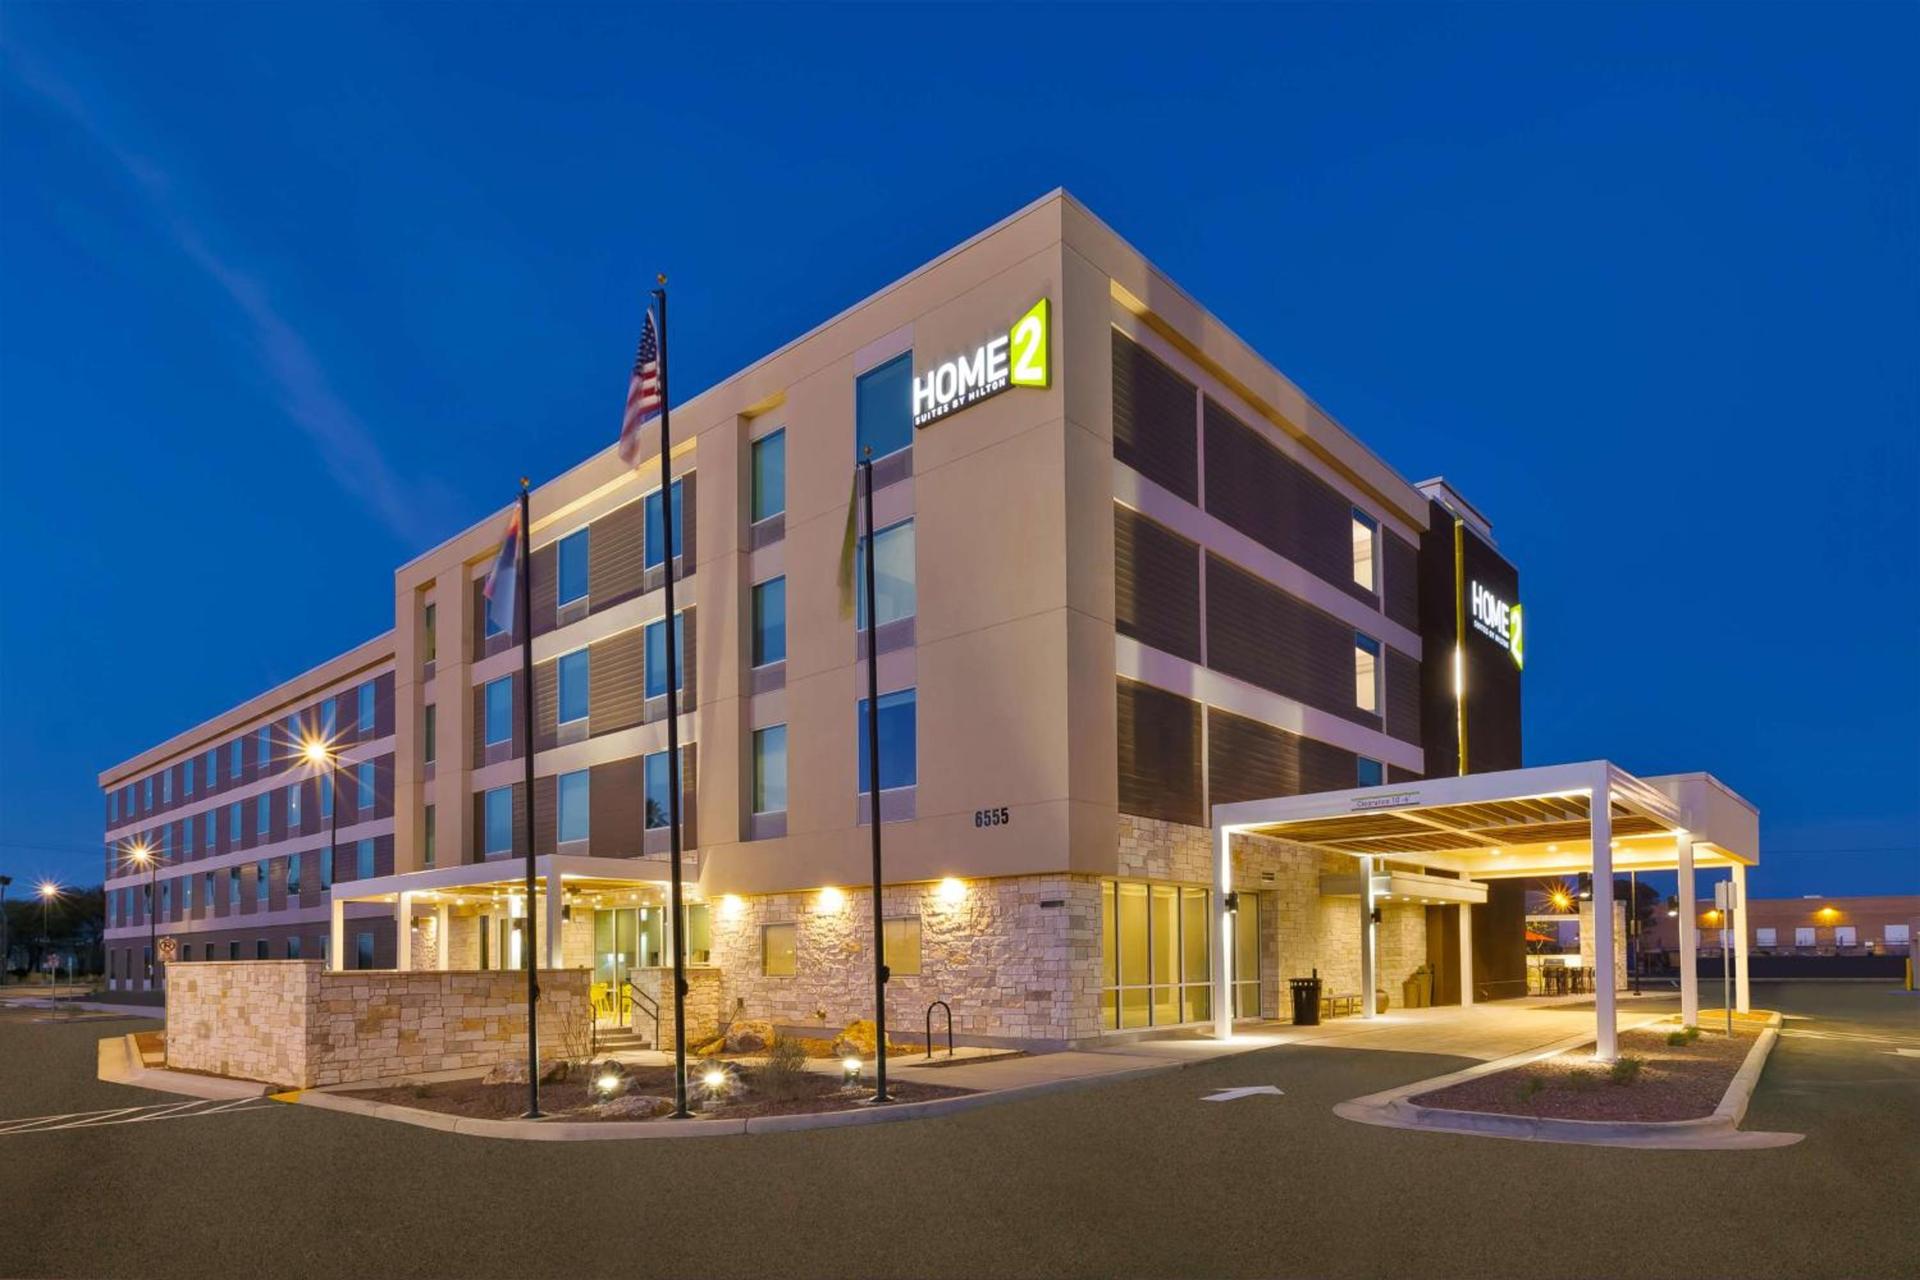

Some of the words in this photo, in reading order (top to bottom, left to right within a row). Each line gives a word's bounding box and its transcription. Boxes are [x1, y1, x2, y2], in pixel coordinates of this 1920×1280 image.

[913, 335, 1009, 416] HOME
[914, 403, 949, 426] SUITES
[952, 395, 966, 409] BY
[968, 377, 1006, 401] HILTON
[1472, 580, 1510, 639] HOME
[975, 807, 1009, 828] 6555
